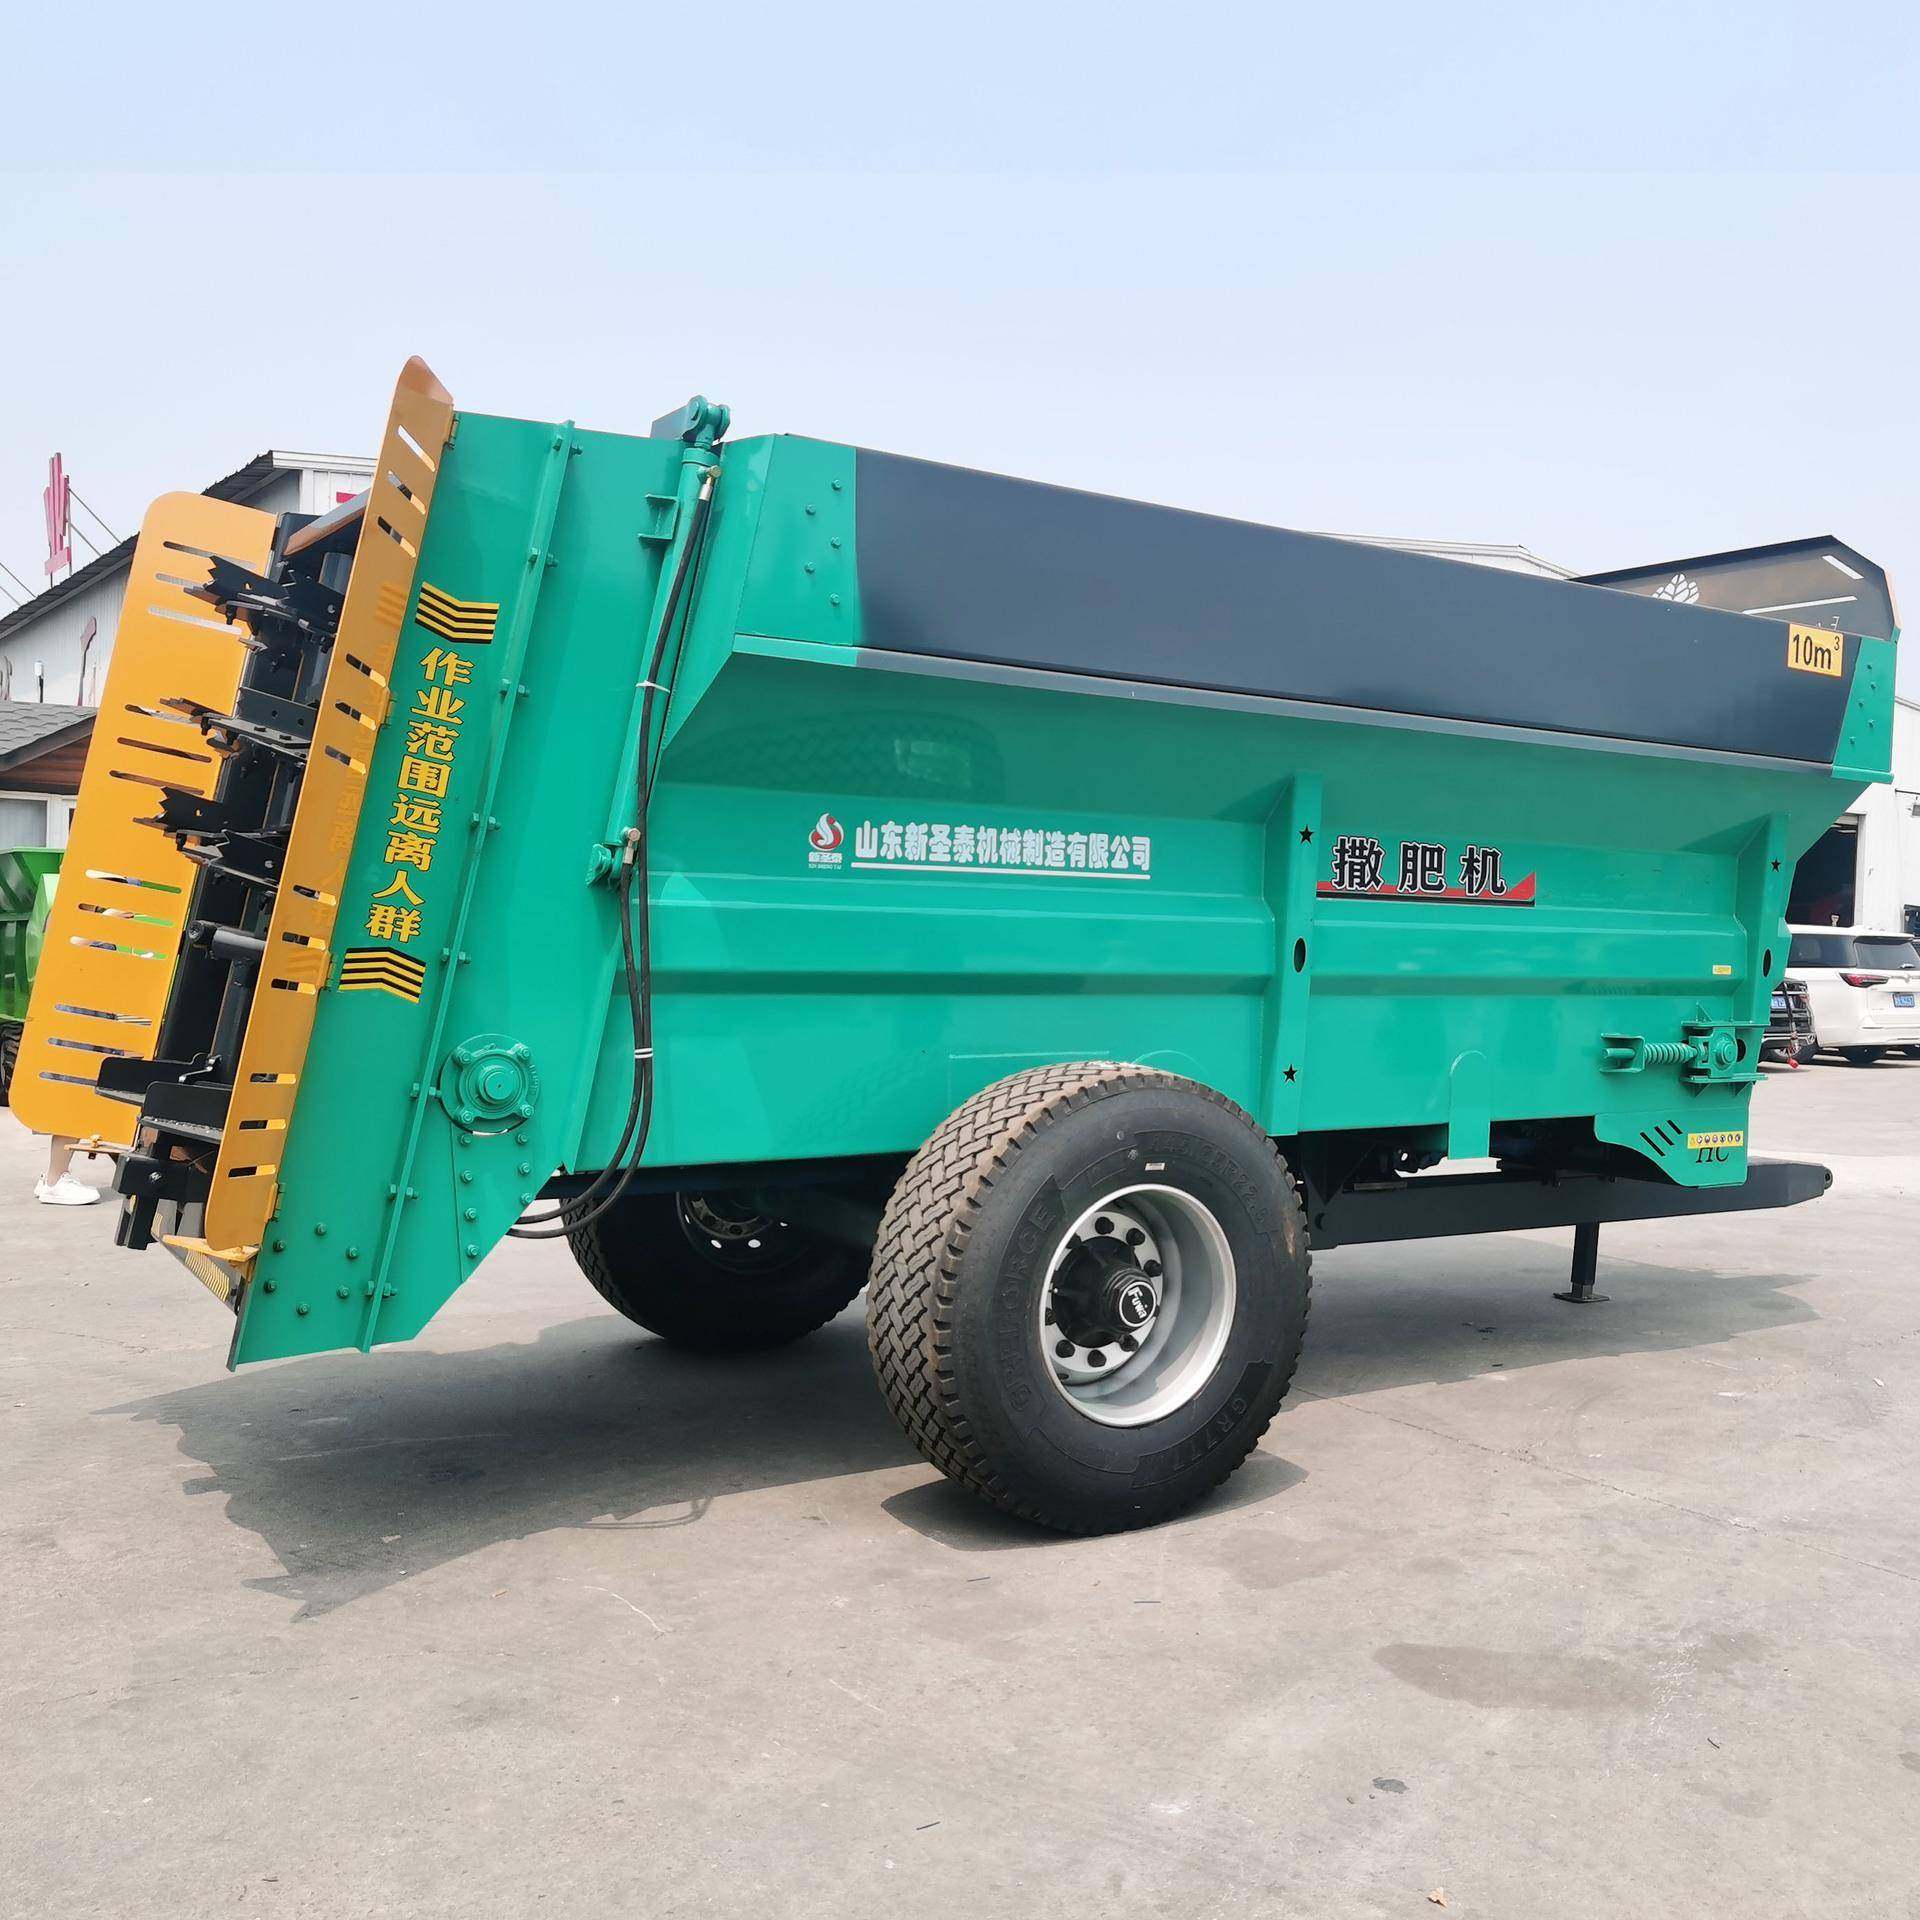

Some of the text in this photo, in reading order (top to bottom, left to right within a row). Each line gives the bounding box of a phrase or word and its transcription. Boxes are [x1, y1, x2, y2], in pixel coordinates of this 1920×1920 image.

[365, 646, 475, 943] 作业范围远离人群
[855, 820, 1151, 871] 山东新圣泰机械制造有限公司
[1331, 835, 1507, 896] 撒肥机
